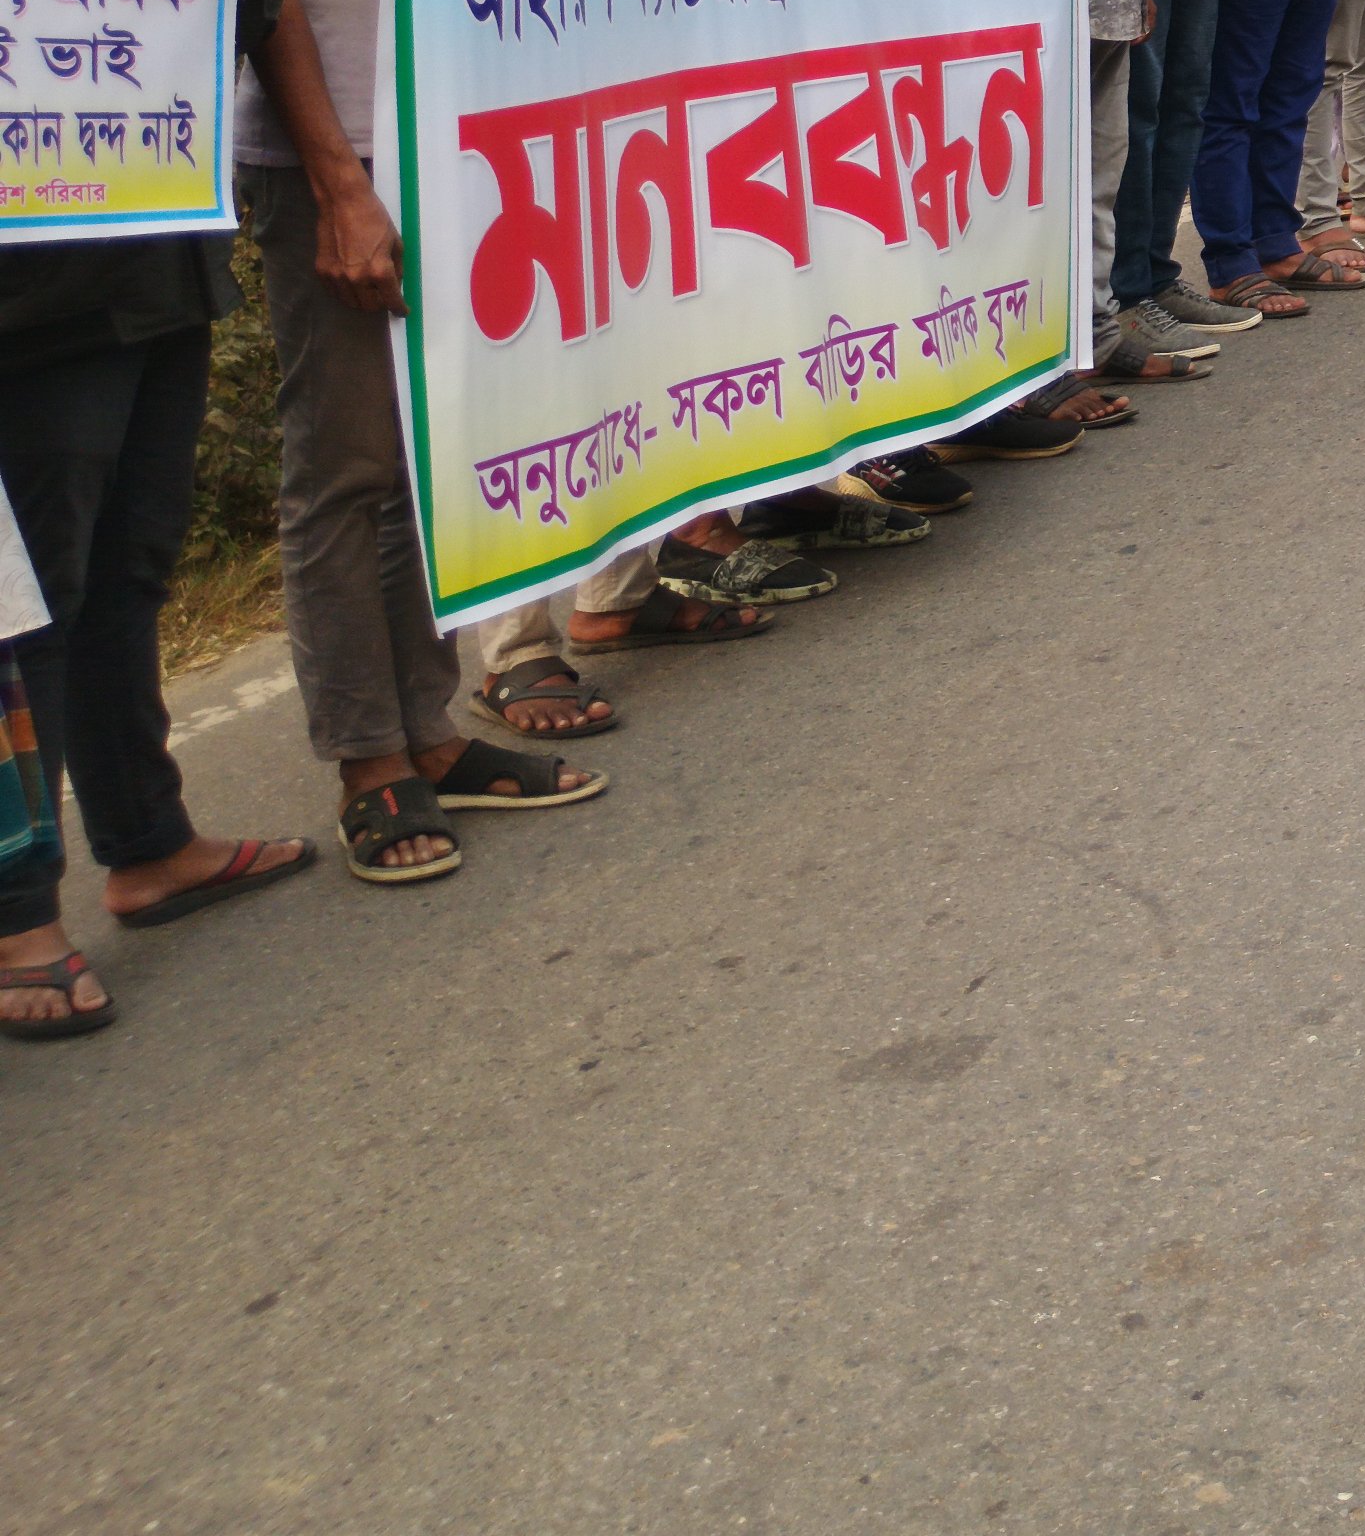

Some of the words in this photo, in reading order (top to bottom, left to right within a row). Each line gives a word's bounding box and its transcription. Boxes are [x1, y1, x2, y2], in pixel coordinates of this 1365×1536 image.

[35, 23, 143, 90] ভাই
[139, 93, 197, 169] নাই
[34, 178, 106, 204] পরিবার
[457, 22, 1045, 345] মানববন্ধন
[667, 358, 785, 441] সকল
[799, 315, 898, 402] বাড়ির
[913, 286, 976, 370] মালিক
